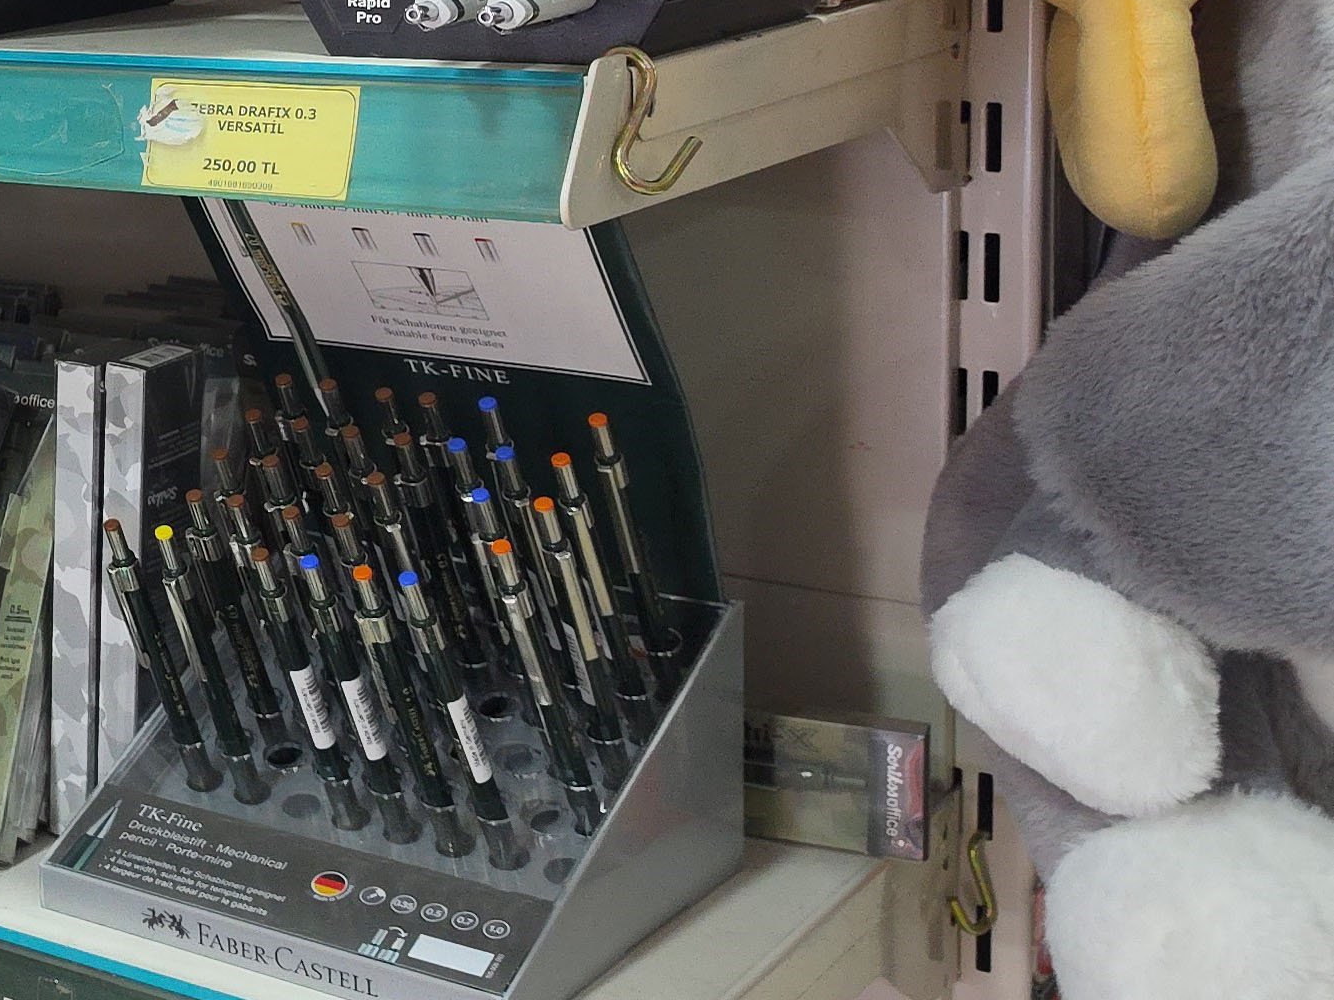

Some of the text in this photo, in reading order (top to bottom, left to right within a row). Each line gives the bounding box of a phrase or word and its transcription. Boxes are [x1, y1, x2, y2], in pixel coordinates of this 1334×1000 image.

[357, 11, 381, 24] Pro
[239, 106, 290, 118] DRAFIX
[295, 108, 316, 119] 0.3
[218, 120, 284, 134] VERSATİL
[203, 158, 279, 174] 250,00 TL
[432, 332, 447, 342] for
[450, 334, 504, 349] templates
[404, 358, 511, 385] TK-FINE
[138, 804, 203, 833] TK-Fine
[119, 831, 233, 869] pencil Porte-mine
[128, 819, 288, 870] Druckbleistift Mechanical
[427, 907, 443, 918] 0.5
[197, 922, 379, 998] FABER-CASTELL
